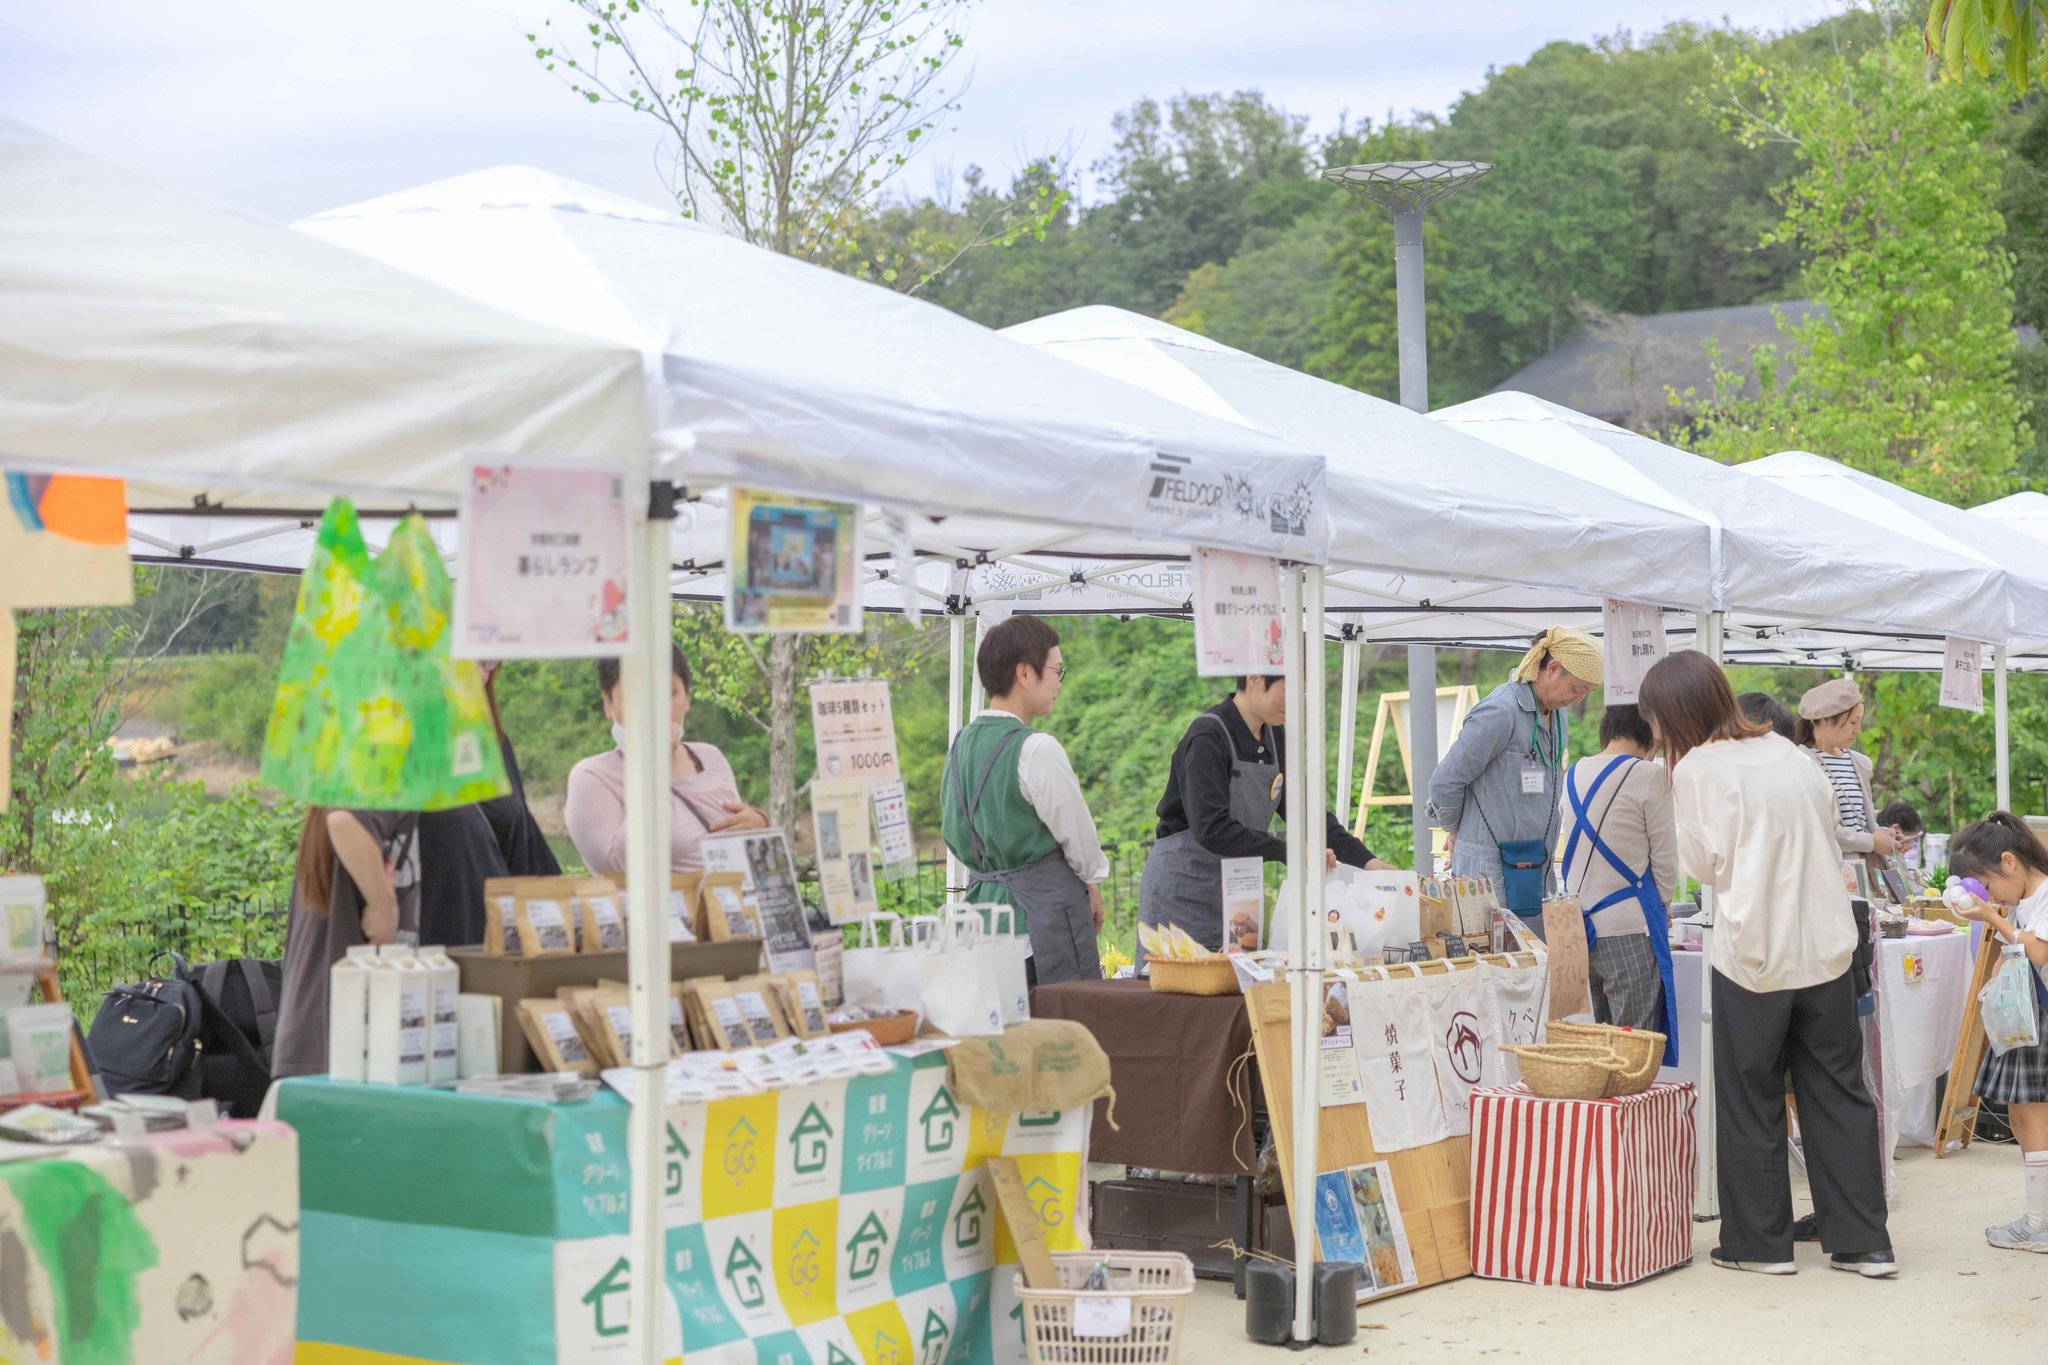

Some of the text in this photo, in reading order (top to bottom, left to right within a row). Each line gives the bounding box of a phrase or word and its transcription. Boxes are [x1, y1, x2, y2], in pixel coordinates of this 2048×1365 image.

[1165, 478, 1224, 508] FIELDOOR
[851, 751, 894, 770] 1000円
[1384, 1022, 1407, 1101] 焼菓子
